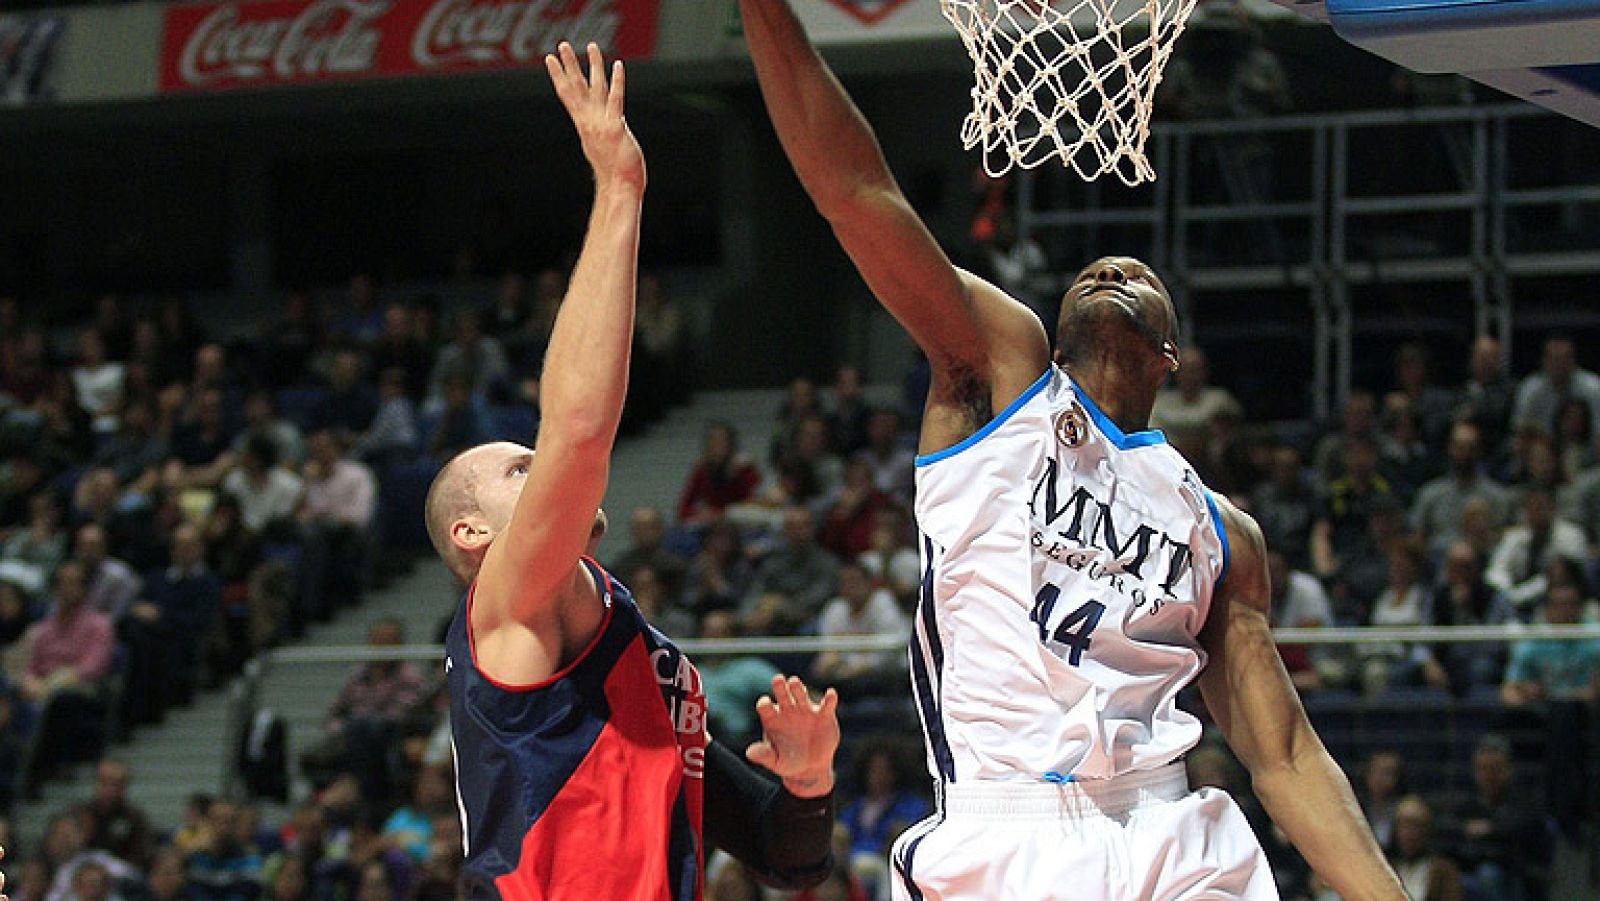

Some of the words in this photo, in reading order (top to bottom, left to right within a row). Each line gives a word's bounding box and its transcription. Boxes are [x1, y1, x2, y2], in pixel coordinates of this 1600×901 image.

[1027, 456, 1193, 599] MMT
[1031, 531, 1165, 616] SEGUROS
[1030, 582, 1106, 668] 44
